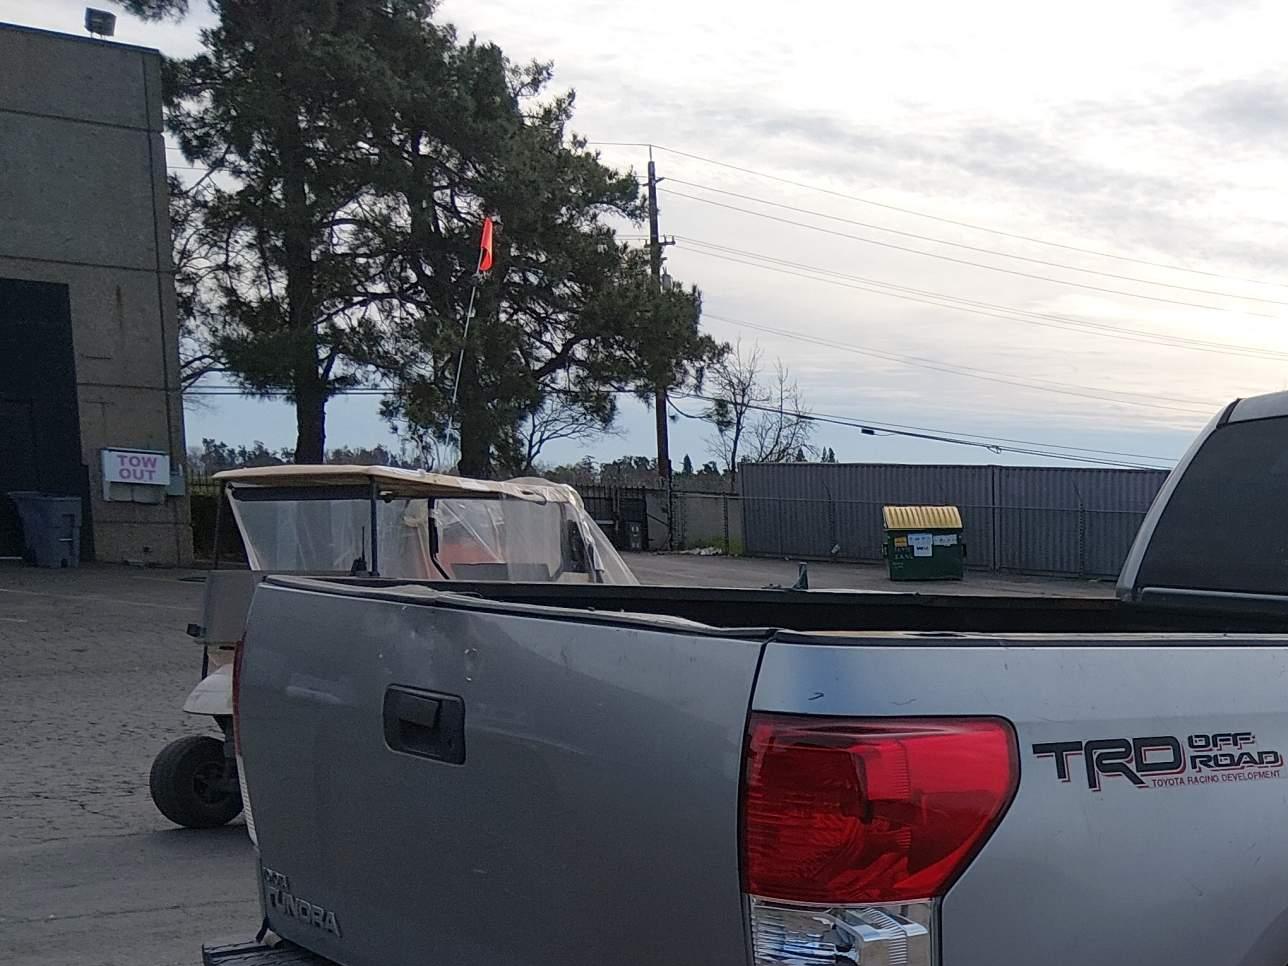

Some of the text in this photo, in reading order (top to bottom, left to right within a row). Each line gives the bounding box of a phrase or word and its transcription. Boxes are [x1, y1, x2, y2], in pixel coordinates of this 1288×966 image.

[117, 455, 157, 468] TOW
[119, 468, 156, 480] OUT
[1188, 732, 1255, 751] OFF
[1032, 736, 1187, 791] TRD
[1190, 751, 1283, 773] ROAD
[1152, 770, 1280, 788] TOYOTA RACING DEVELOPMENT
[266, 886, 341, 938] TUNDRA
